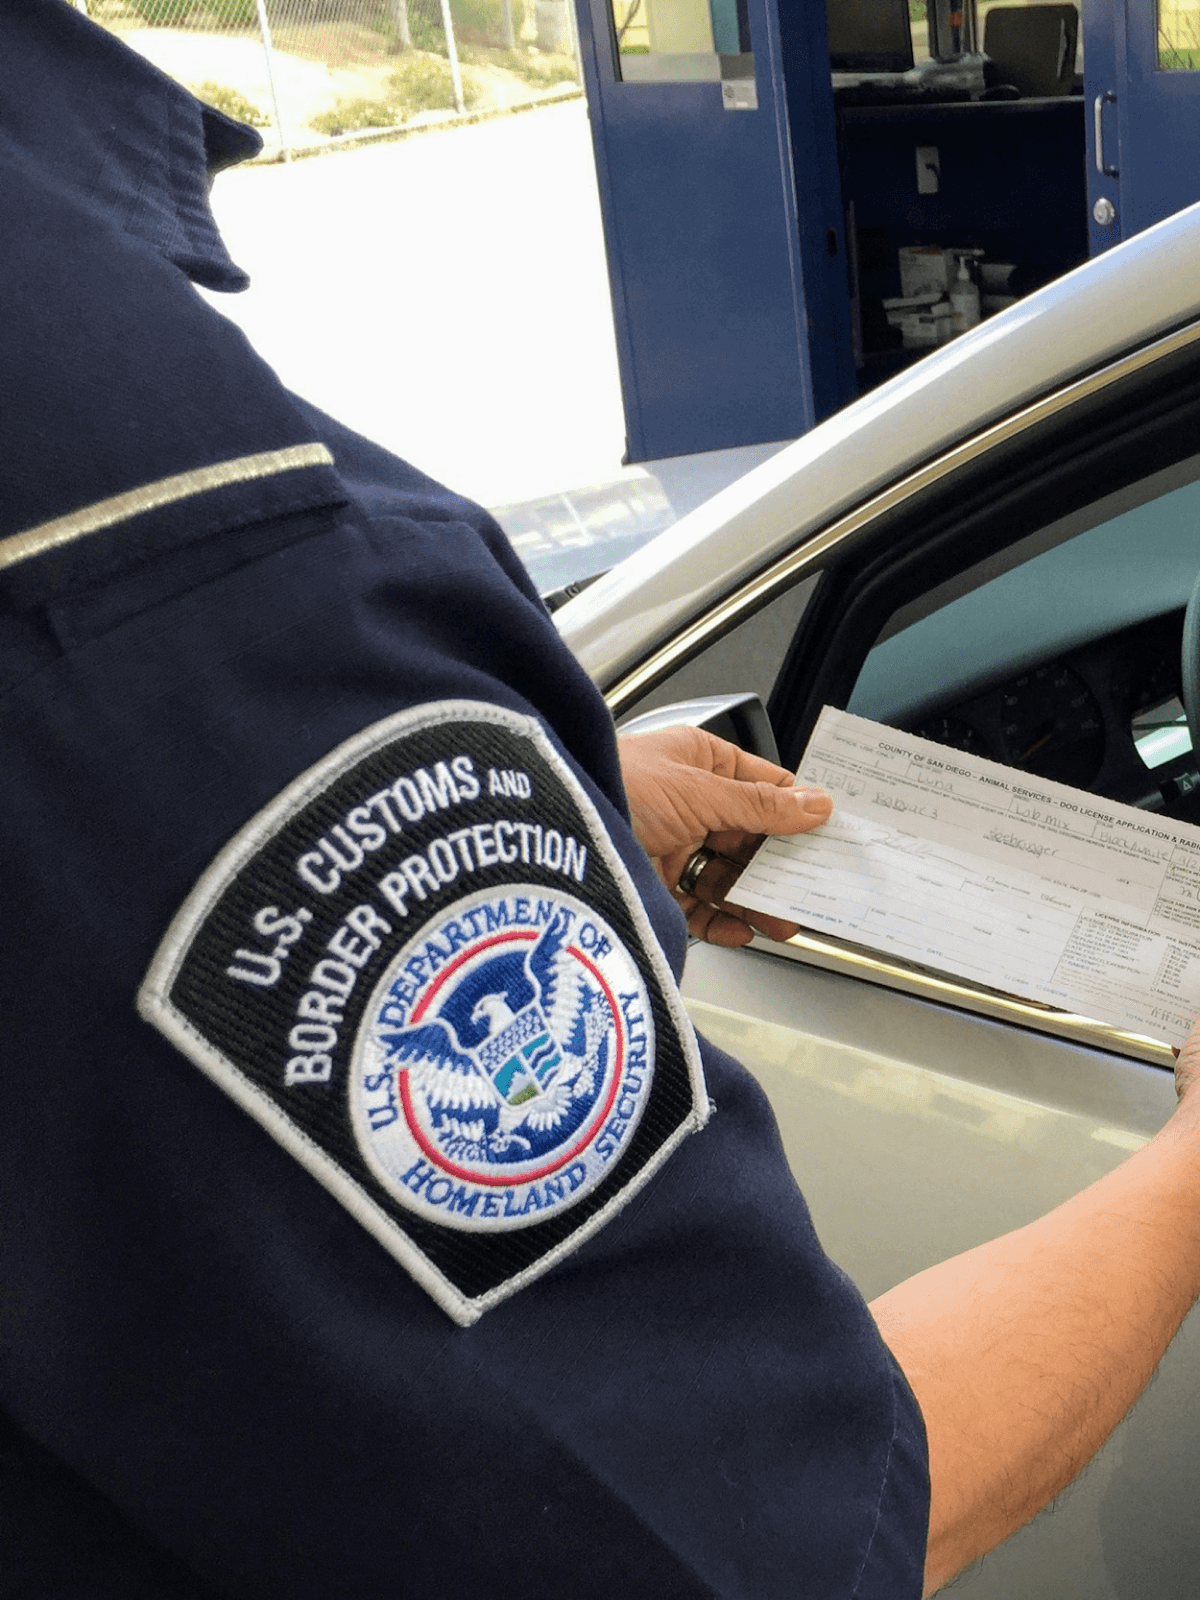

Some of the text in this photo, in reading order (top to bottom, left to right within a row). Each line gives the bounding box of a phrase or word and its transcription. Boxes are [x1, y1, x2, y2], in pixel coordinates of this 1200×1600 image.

[227, 756, 532, 988] U.S. CUSTOMS AND
[877, 741, 912, 757] COUNTY
[913, 753, 925, 762] OF
[926, 757, 944, 768] SAN
[944, 764, 972, 777] DIEGO
[978, 775, 1010, 790] ANIMAL
[1011, 786, 1052, 803] SERVICES
[1059, 801, 1078, 811] DOG
[1079, 807, 1115, 823] LICENSE
[1115, 818, 1170, 840] APPLICATION
[1170, 835, 1178, 843] &
[285, 822, 587, 1087] BORDER PROTECTION
[377, 898, 612, 1028] DEPARTMENT OF
[400, 990, 648, 1218] HOMELAND SECURITY
